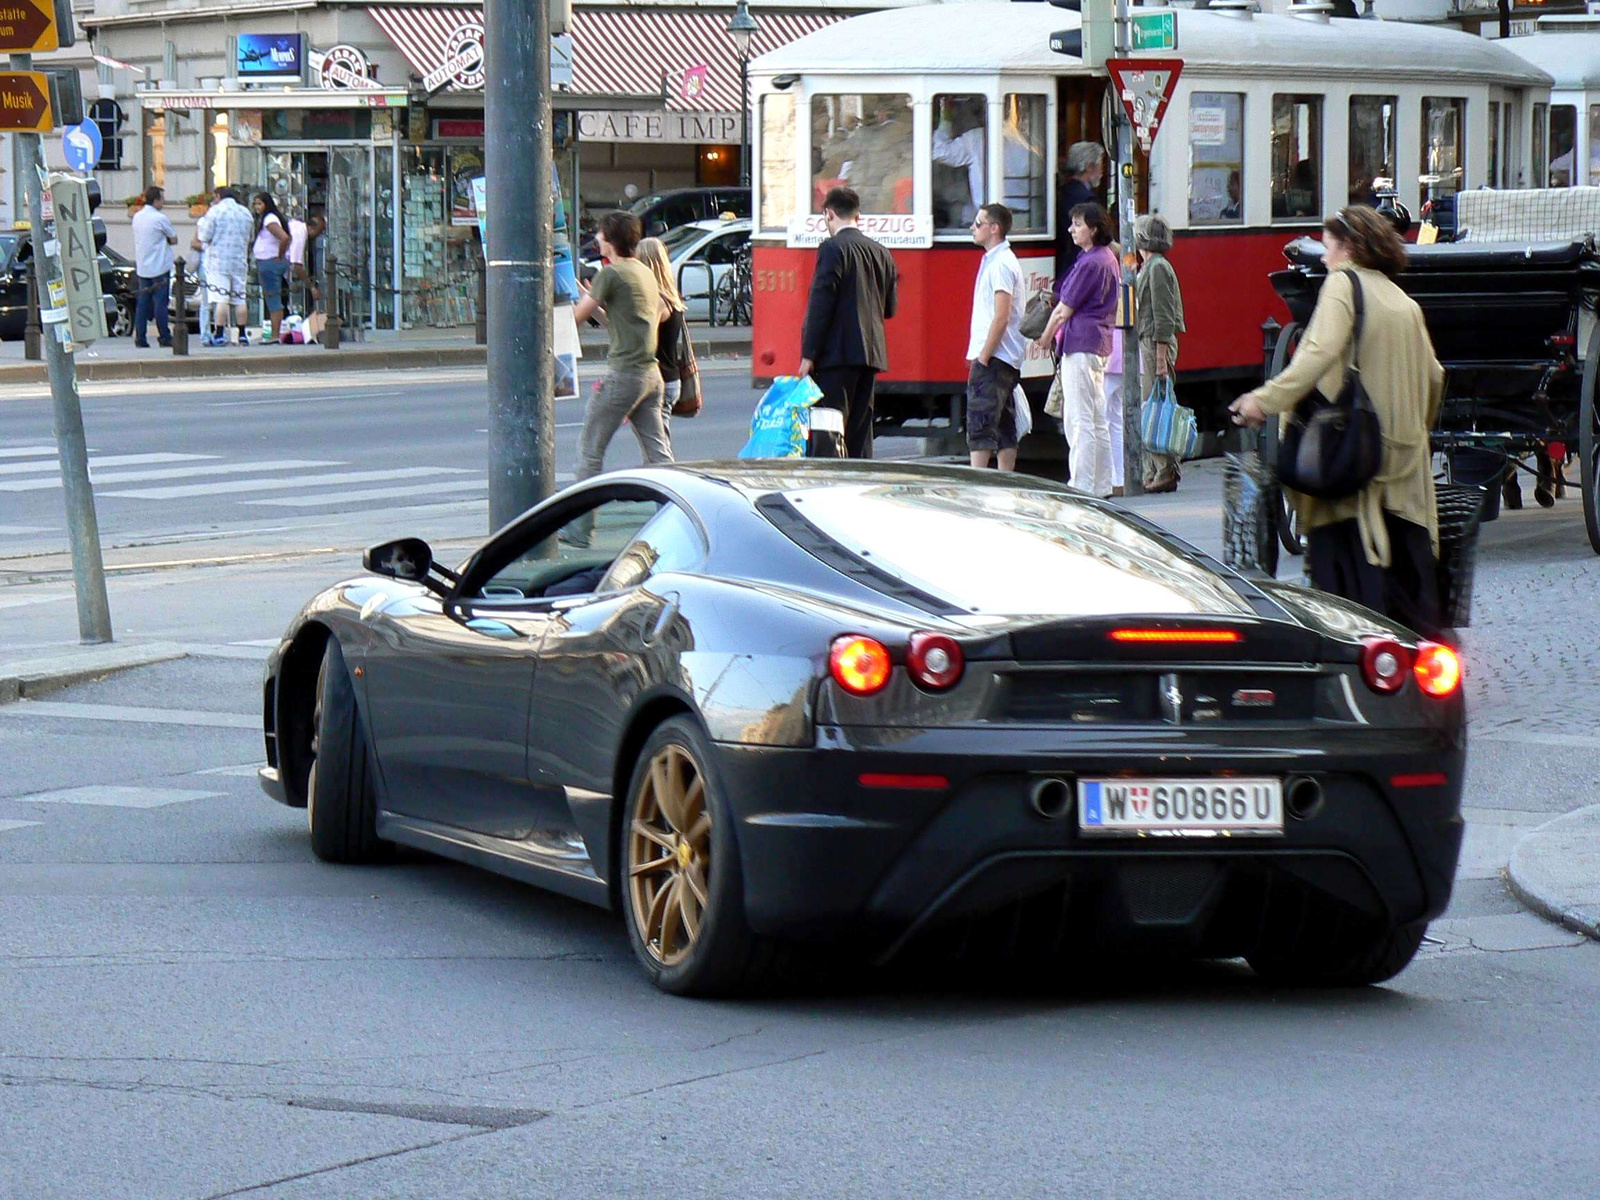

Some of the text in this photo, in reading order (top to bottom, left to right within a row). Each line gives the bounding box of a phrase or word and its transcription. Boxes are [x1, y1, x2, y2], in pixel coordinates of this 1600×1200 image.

[1509, 21, 1530, 35] TEL
[448, 29, 482, 59] TABAK
[328, 49, 362, 72] TABAK
[428, 47, 480, 89] AUTOMAT
[2, 91, 33, 110] Musik
[160, 97, 213, 109] AUTOMAT
[578, 113, 742, 140] CAFE IMP
[804, 217, 916, 233] SOERZUG
[793, 233, 827, 245] Wiene
[757, 270, 796, 292] 5311
[1106, 787, 1127, 820] W
